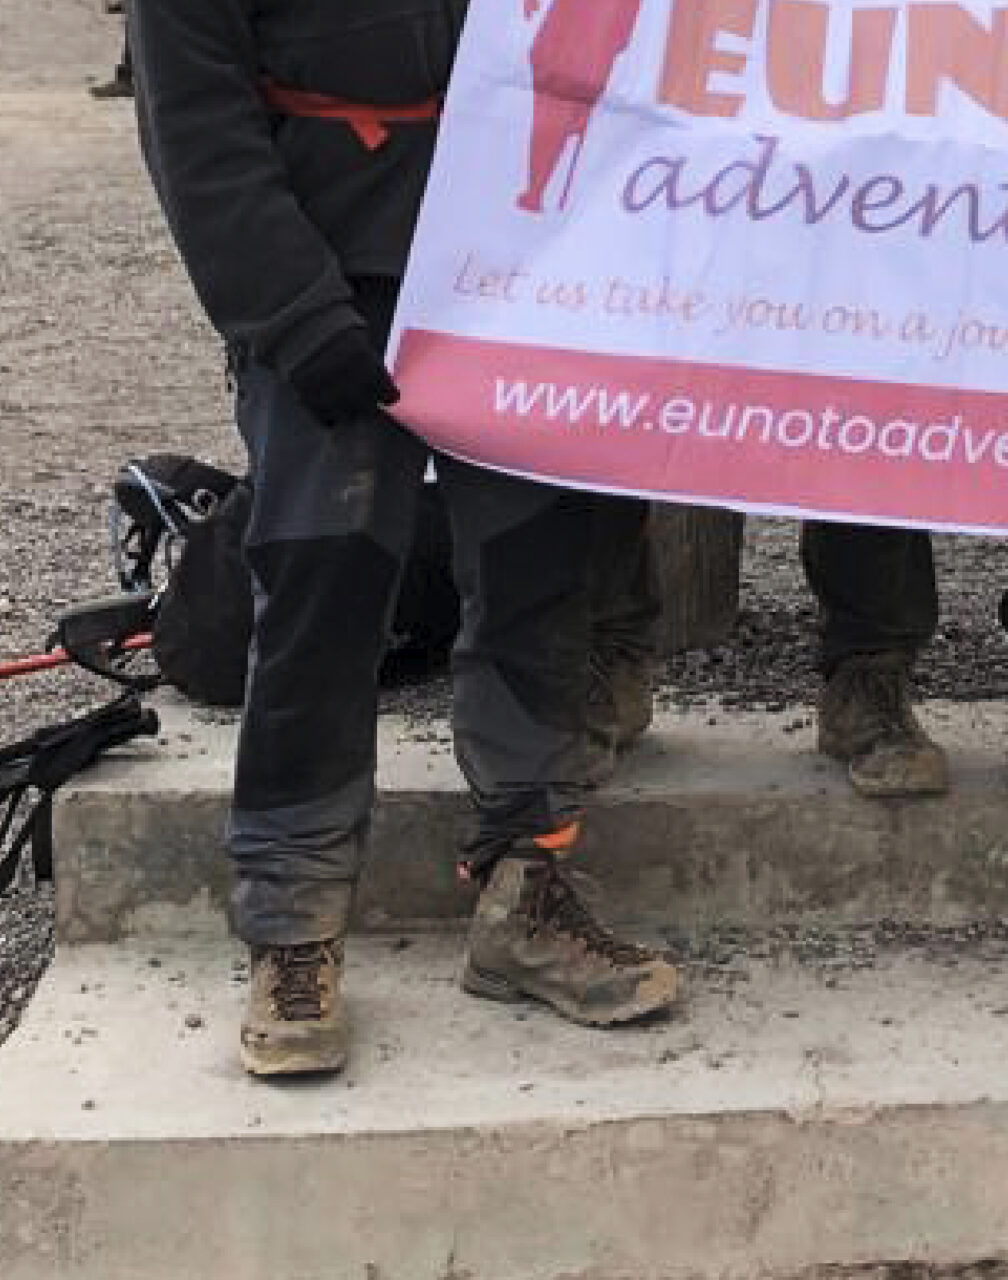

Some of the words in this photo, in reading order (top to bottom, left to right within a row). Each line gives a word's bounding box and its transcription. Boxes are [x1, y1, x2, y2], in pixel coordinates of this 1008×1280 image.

[452, 246, 528, 304] Let
[535, 279, 588, 305] us
[602, 273, 703, 324] take
[712, 296, 806, 337] you
[821, 304, 886, 341] on
[900, 312, 934, 342] a
